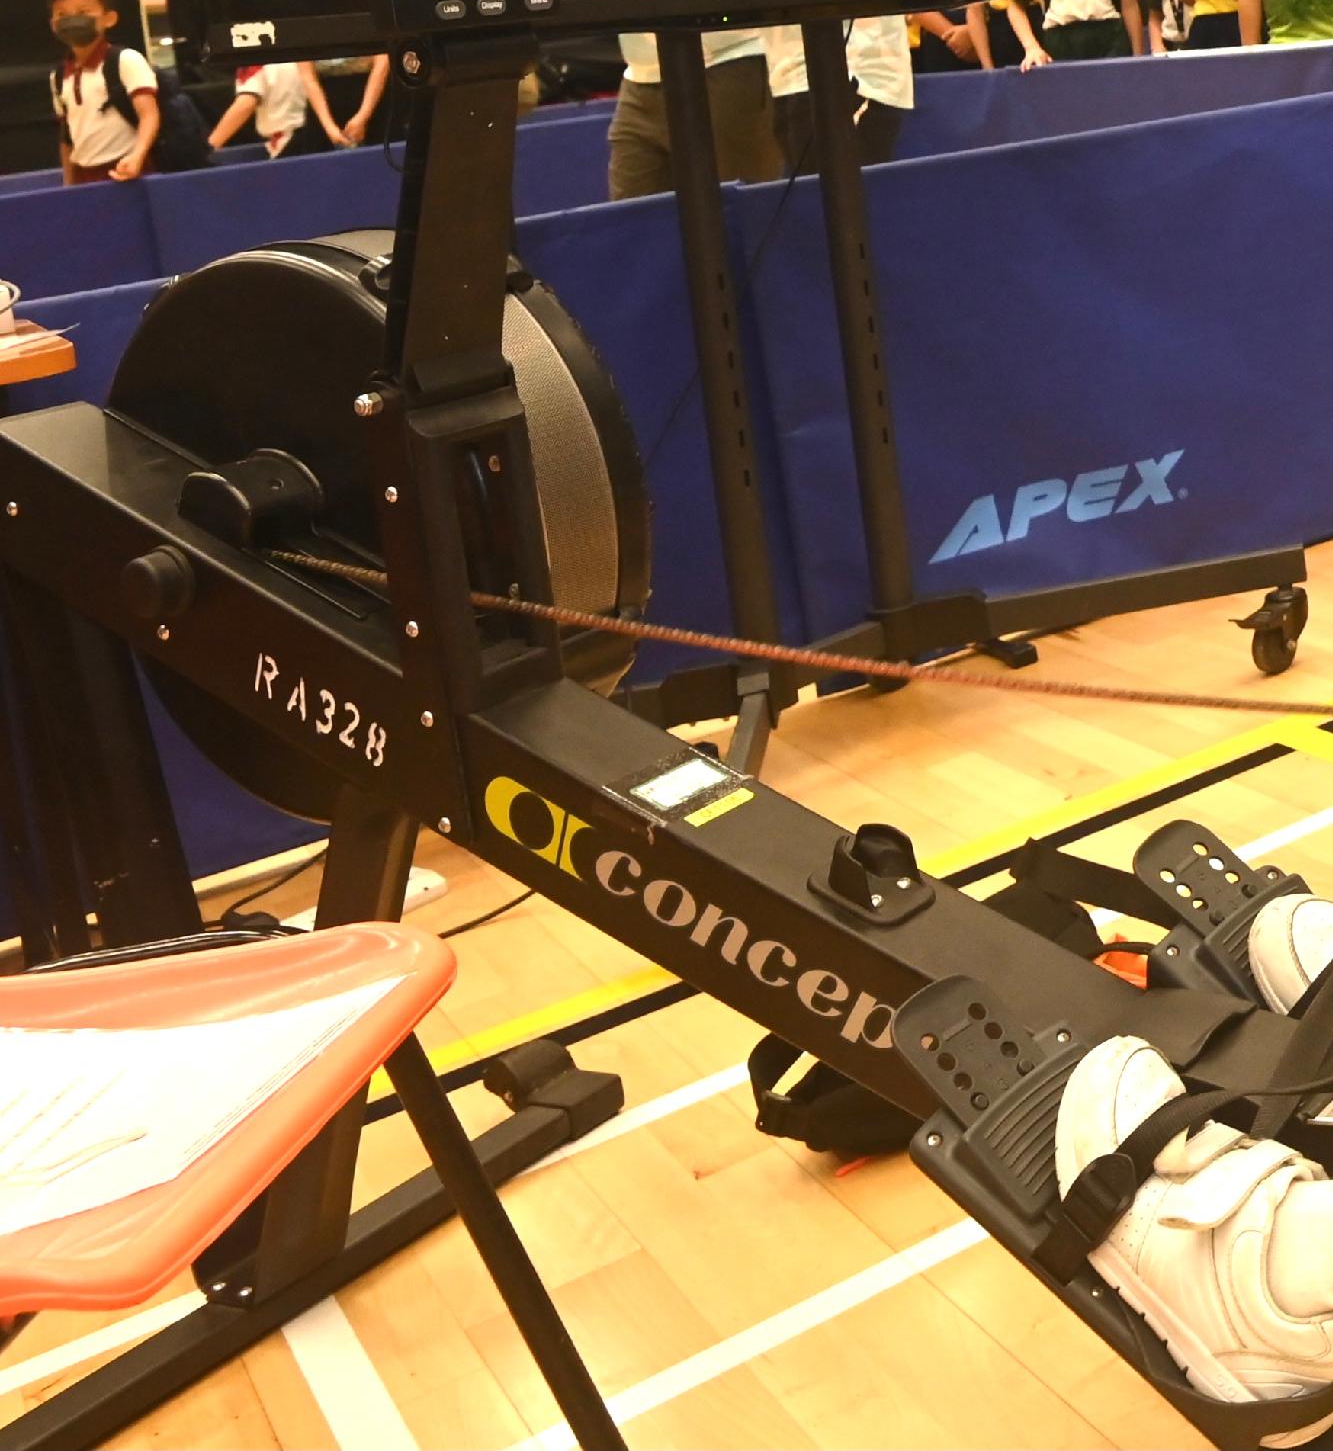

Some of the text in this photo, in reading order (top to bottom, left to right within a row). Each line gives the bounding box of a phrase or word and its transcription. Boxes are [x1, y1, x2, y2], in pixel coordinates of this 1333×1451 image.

[443, 3, 460, 13] Units
[481, 0, 503, 11] Display
[928, 449, 1185, 564] APEX
